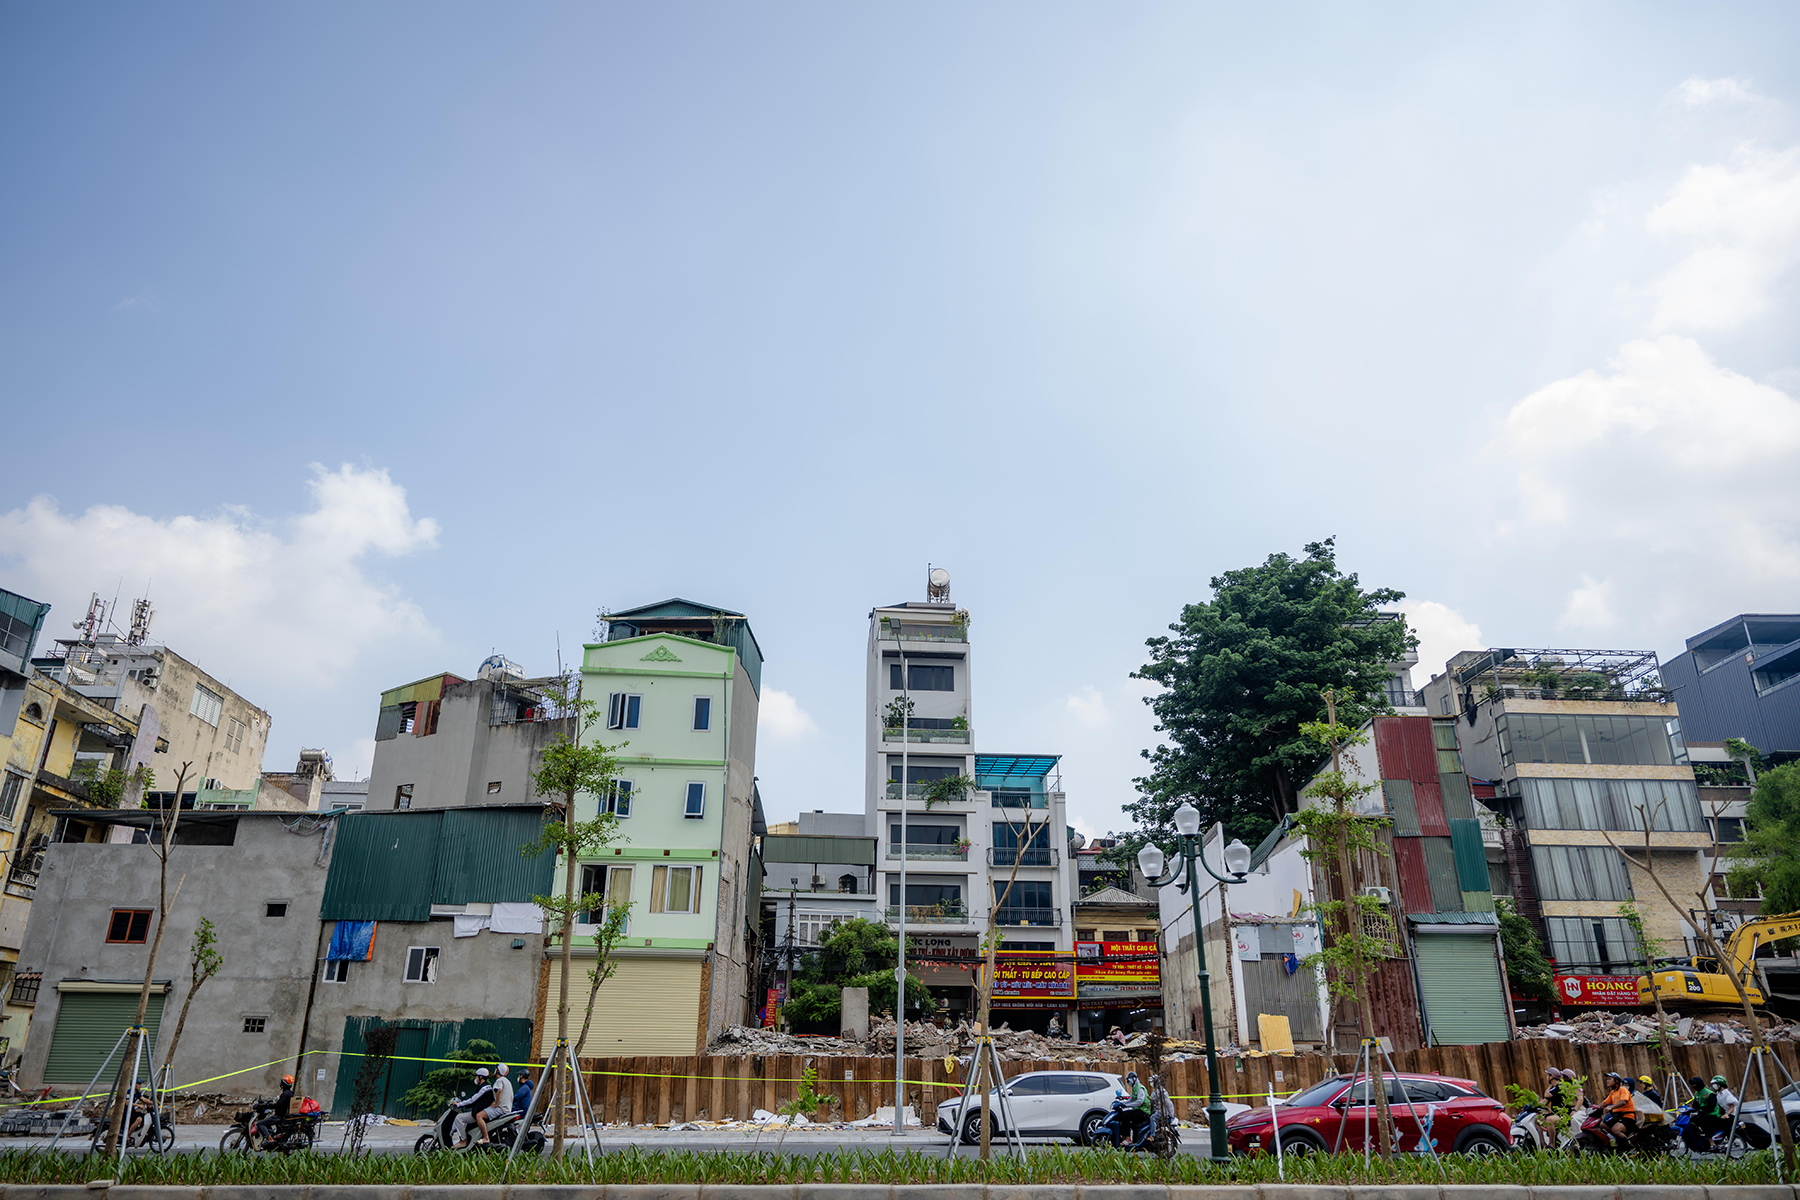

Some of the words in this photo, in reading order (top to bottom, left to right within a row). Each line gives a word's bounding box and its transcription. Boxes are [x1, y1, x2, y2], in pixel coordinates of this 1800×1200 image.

[1111, 944, 1121, 952] NỘI
[1122, 943, 1135, 951] THẤT
[1149, 943, 1157, 951] CẤ
[1002, 968, 1017, 979] THẤT
[1022, 967, 1030, 979] TỦ
[1031, 968, 1043, 979] BẾP
[1044, 971, 1056, 979] CAO
[1058, 968, 1070, 979] CẤP
[1567, 982, 1579, 991] HN
